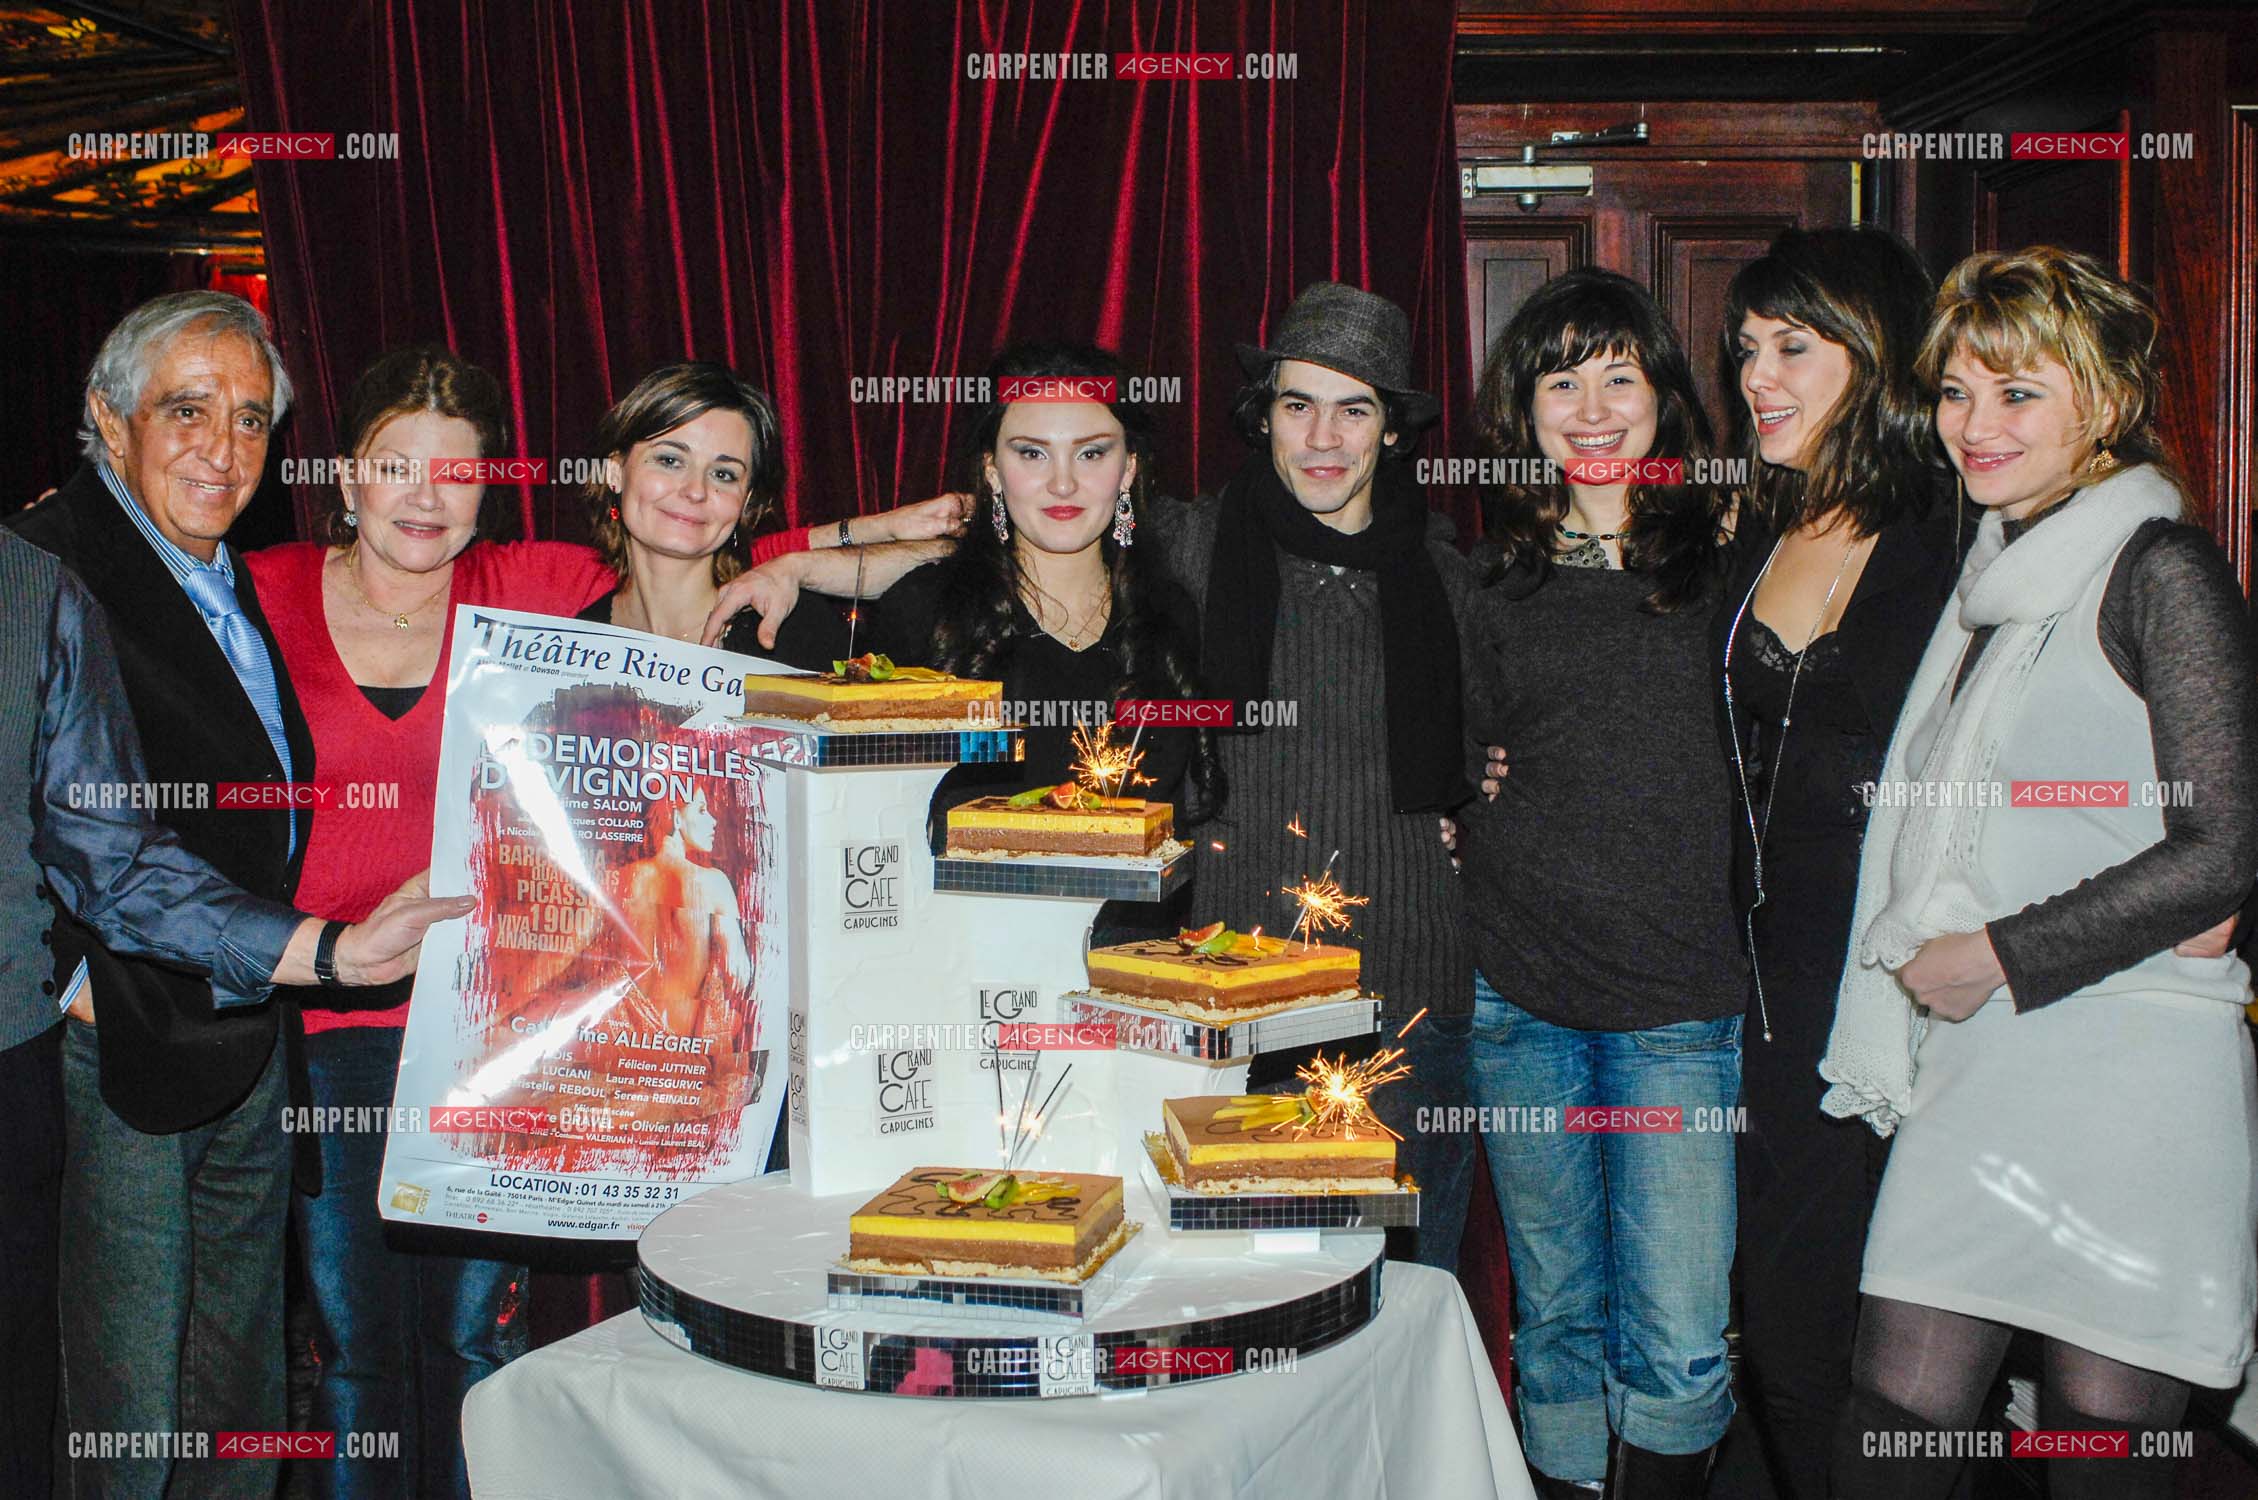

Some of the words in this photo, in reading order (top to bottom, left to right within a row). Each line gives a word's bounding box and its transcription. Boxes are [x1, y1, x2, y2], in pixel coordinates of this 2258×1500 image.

[474, 613, 610, 670] Théâtre
[620, 646, 691, 685] Rive
[701, 666, 742, 697] Ga
[480, 761, 693, 803] DVIGNON
[593, 799, 642, 813] SALOM
[507, 826, 537, 837] Nicola
[595, 832, 643, 843] LASSERRE
[597, 817, 644, 829] COLLARD
[857, 845, 899, 876] GRAND
[517, 879, 592, 908] PICASS
[845, 877, 899, 909] CAFE
[497, 914, 531, 933] VIVA
[530, 904, 591, 935] 1900
[844, 915, 898, 930] CAPUCINES
[495, 931, 576, 954] ANARQUIA
[994, 990, 1037, 1019] GRAND
[615, 1030, 714, 1055] ALLÉGRET
[618, 1058, 657, 1072] Félicien
[660, 1061, 706, 1076] JUTTNER
[891, 1048, 932, 1080] GRAND
[542, 1065, 591, 1081] LUCIANI
[606, 1073, 635, 1086] Laura
[637, 1075, 704, 1092] PRESGURVIC
[558, 1083, 606, 1098] REBOUL
[614, 1089, 650, 1103] Serena
[651, 1092, 701, 1106] REINALDI
[880, 1080, 933, 1113] CAFE
[631, 1120, 670, 1133] Olivier
[880, 1116, 934, 1134] CAPUCINES
[585, 1132, 626, 1144] VALERIAN
[467, 1186, 476, 1195] de
[507, 1192, 527, 1200] 75014
[528, 1194, 543, 1203] Paris
[490, 1174, 572, 1195] LOCATION
[602, 1185, 620, 1198] 43
[623, 1185, 641, 1199] 35
[644, 1186, 661, 1200] 32
[664, 1187, 680, 1200] 31
[547, 1219, 620, 1232] www.edgar.fr
